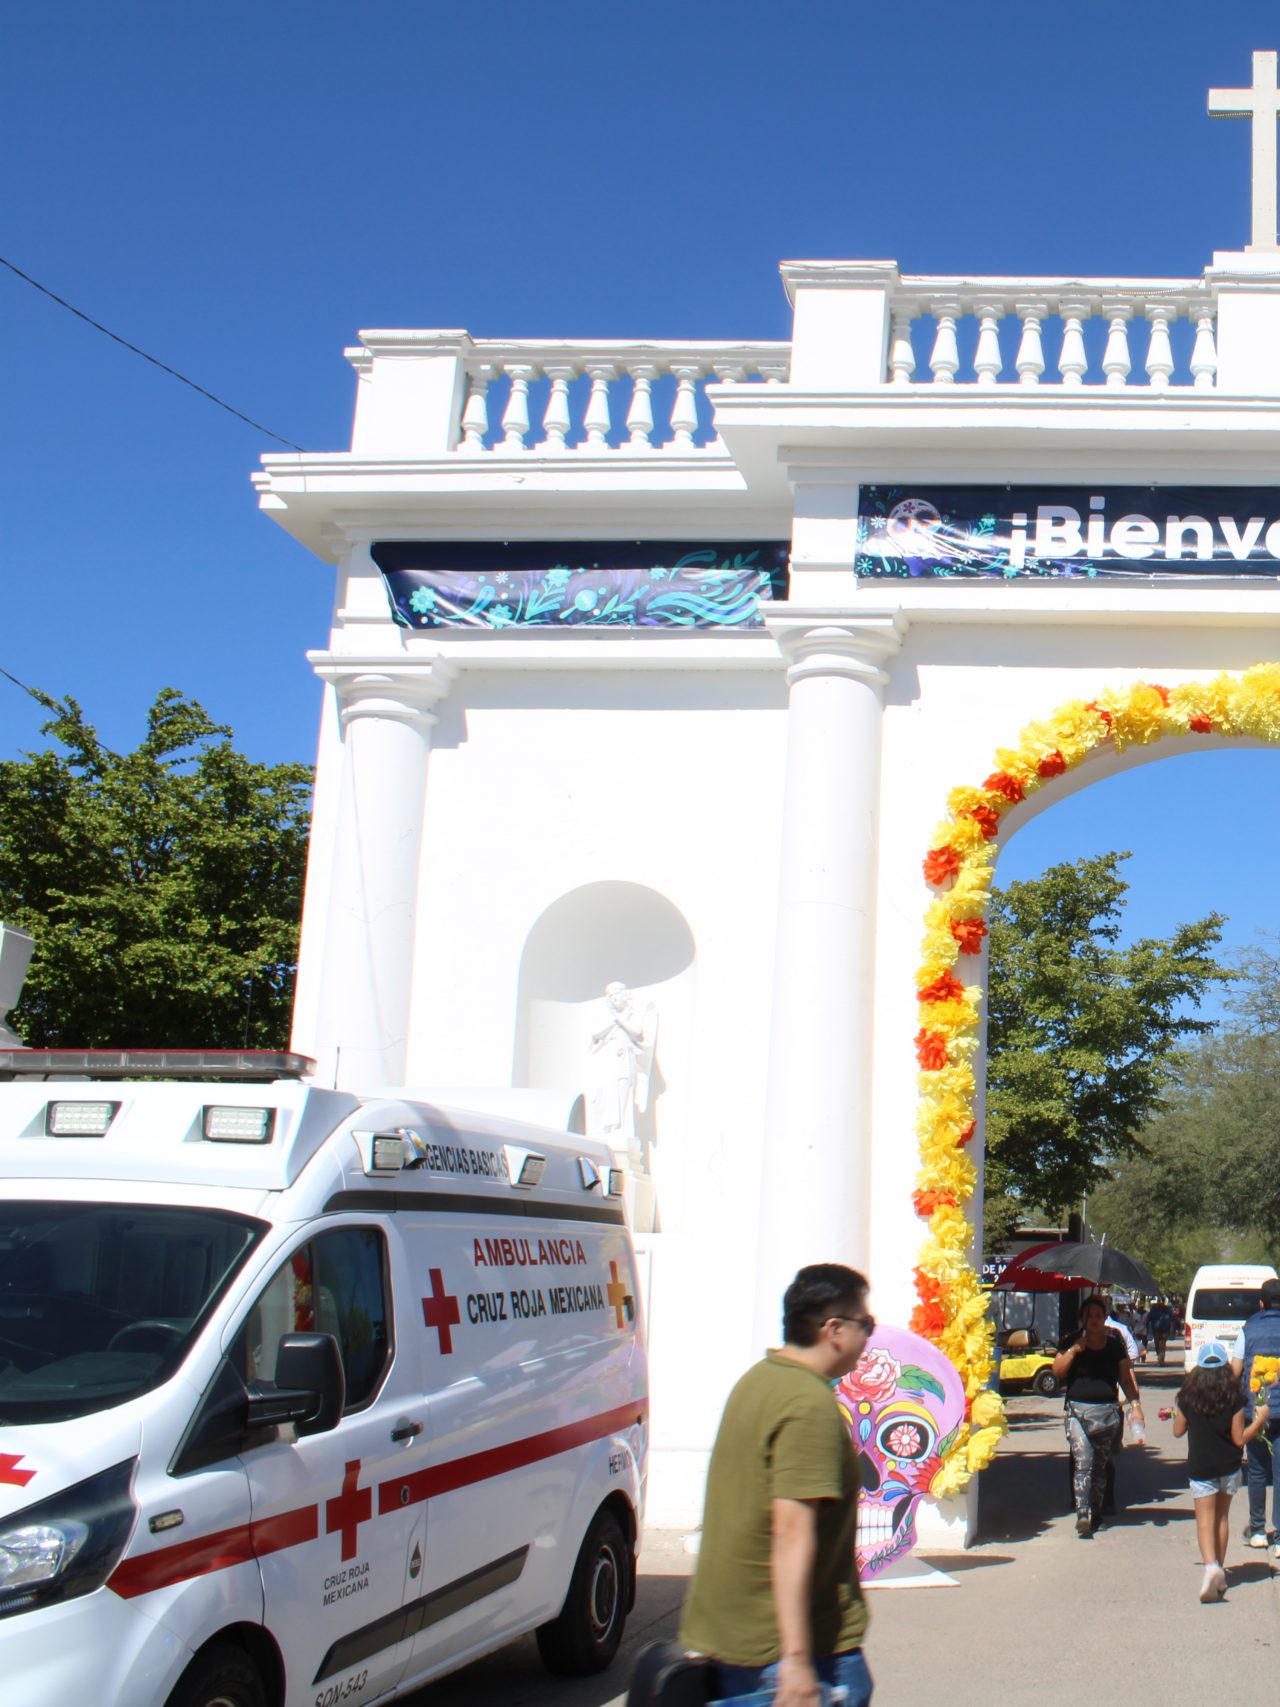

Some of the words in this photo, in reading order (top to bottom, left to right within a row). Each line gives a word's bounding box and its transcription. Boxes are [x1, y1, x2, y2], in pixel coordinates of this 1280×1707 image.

[471, 1149, 509, 1178] BASICAS
[473, 1238, 587, 1267] AMBULANCIA
[982, 1264, 996, 1274] DE
[467, 1291, 507, 1324] CRUZ
[510, 1288, 546, 1319] ROJA
[549, 1284, 605, 1315] MEXICANA
[324, 1572, 347, 1590] CRUZ
[348, 1561, 370, 1580] ROJA
[323, 1577, 369, 1607] MEXICANA
[315, 1669, 368, 1707] SON-543
